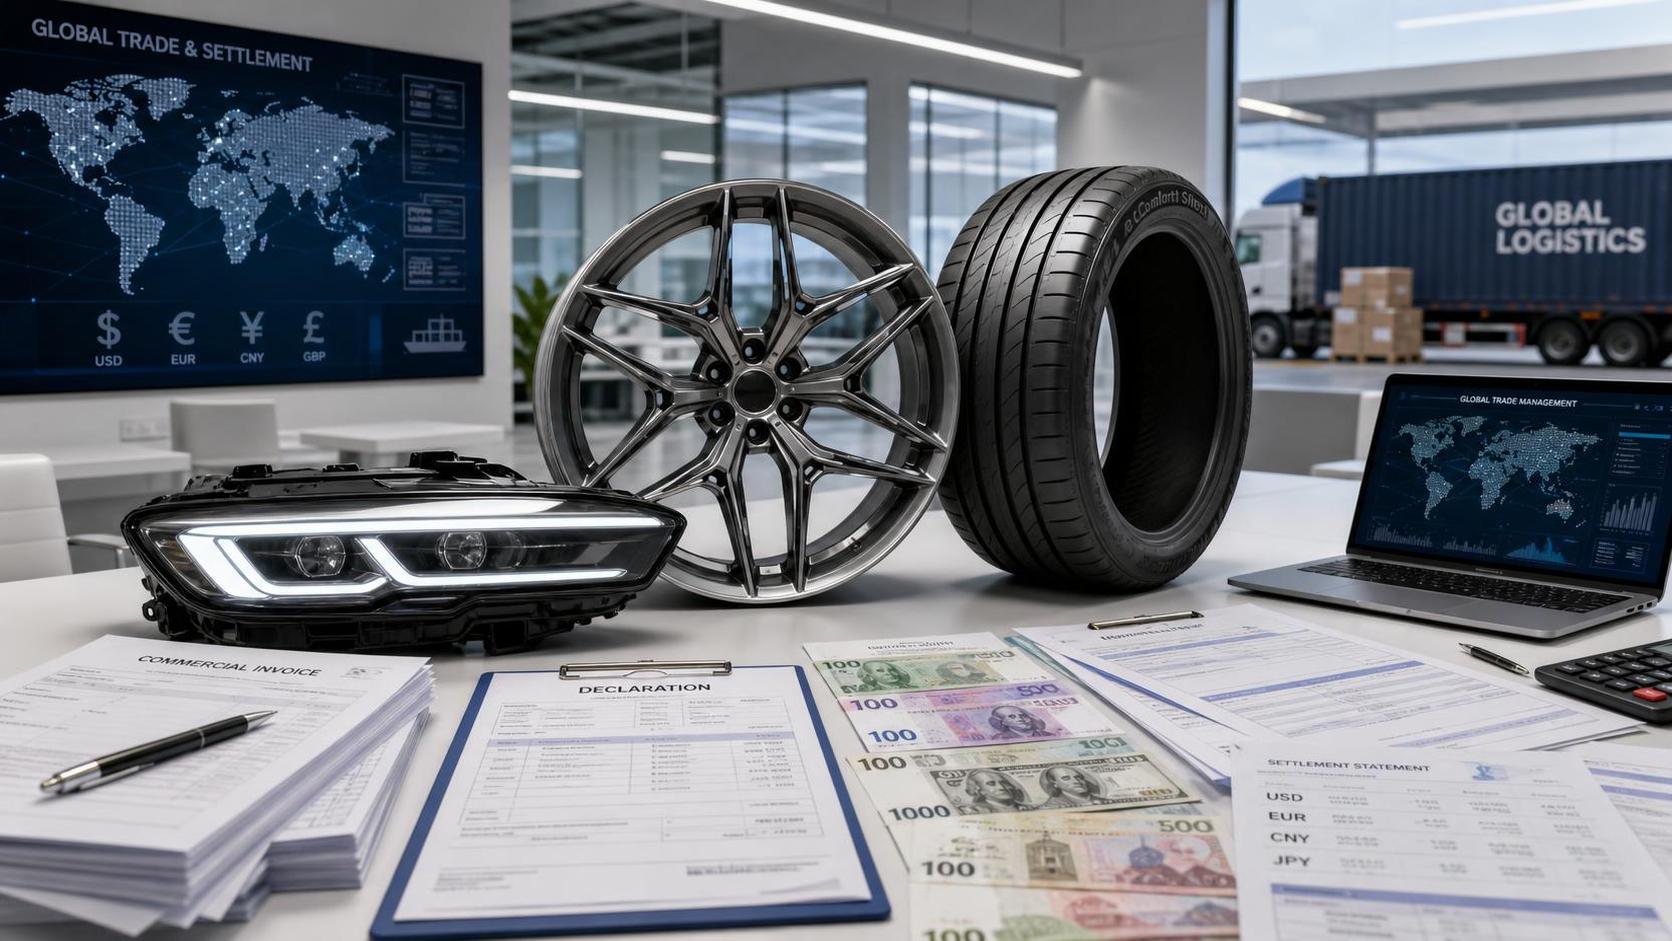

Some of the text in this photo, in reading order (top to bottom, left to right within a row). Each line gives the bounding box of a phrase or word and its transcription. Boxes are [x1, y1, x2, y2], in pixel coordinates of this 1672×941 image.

[31, 18, 313, 73] GLOBAL TRADE & SETTLEMENT
[1495, 199, 1611, 230] GLOBAL
[1496, 227, 1646, 255] LOGISTICS
[95, 354, 123, 367] USD
[171, 353, 196, 366] EUR
[239, 352, 265, 364] CNY
[303, 351, 326, 363] GBP
[1460, 395, 1578, 408] GLOBAL TRADE MANAGEMENT
[138, 655, 322, 678] COMMERCIAL INVOICE
[822, 660, 861, 670] 100
[578, 683, 711, 695] DECLARATION
[850, 697, 898, 711] 100
[868, 728, 918, 743] 100
[857, 756, 908, 771] 100
[1268, 758, 1431, 773] SETTLEMENT STATEMENT
[1266, 791, 1304, 803] USD
[888, 804, 951, 821] 1000
[1268, 811, 1307, 823] EUR
[1159, 818, 1214, 833] 500
[1270, 831, 1310, 844] CNY
[1272, 854, 1311, 868] JPY
[921, 861, 976, 877] 100
[922, 927, 985, 941] 100
